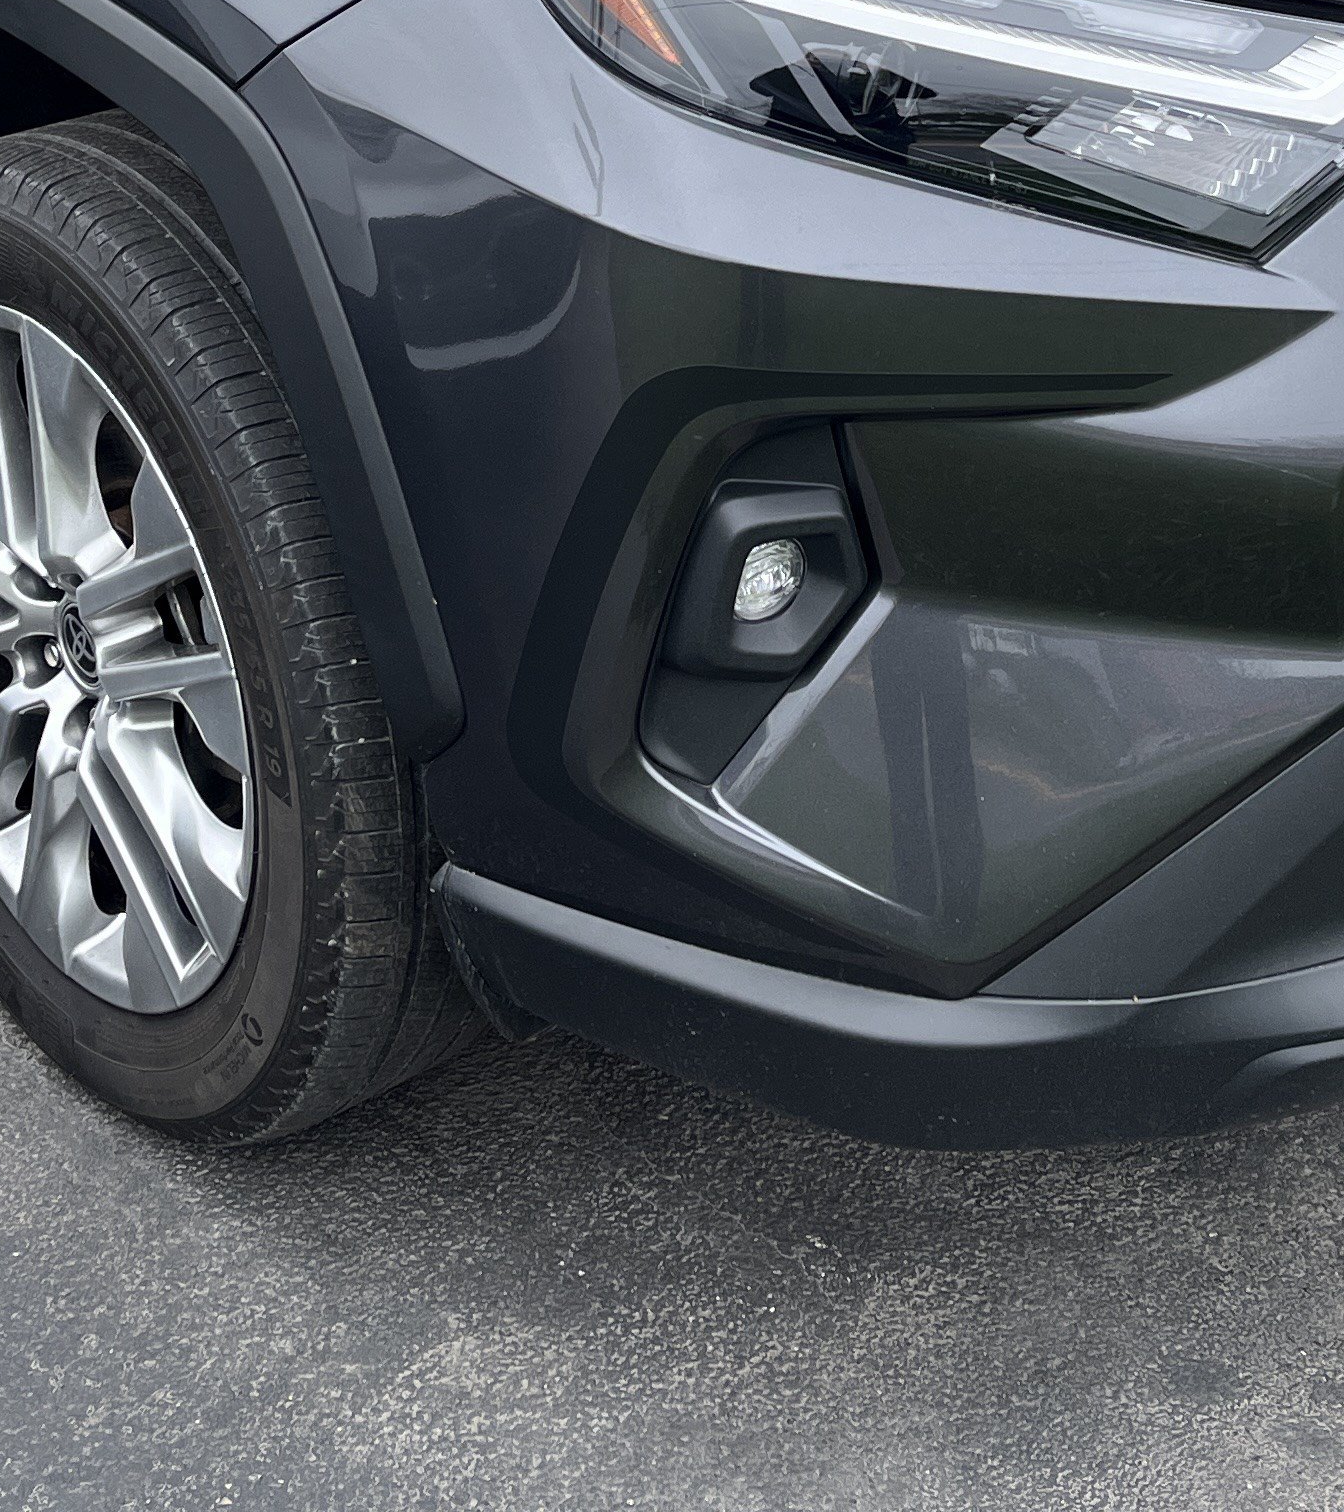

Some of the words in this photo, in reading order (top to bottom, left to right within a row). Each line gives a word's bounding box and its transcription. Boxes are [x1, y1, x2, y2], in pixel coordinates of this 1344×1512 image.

[48, 279, 209, 514] MICHELIN
[256, 703, 273, 728] R
[263, 743, 282, 776] 19
